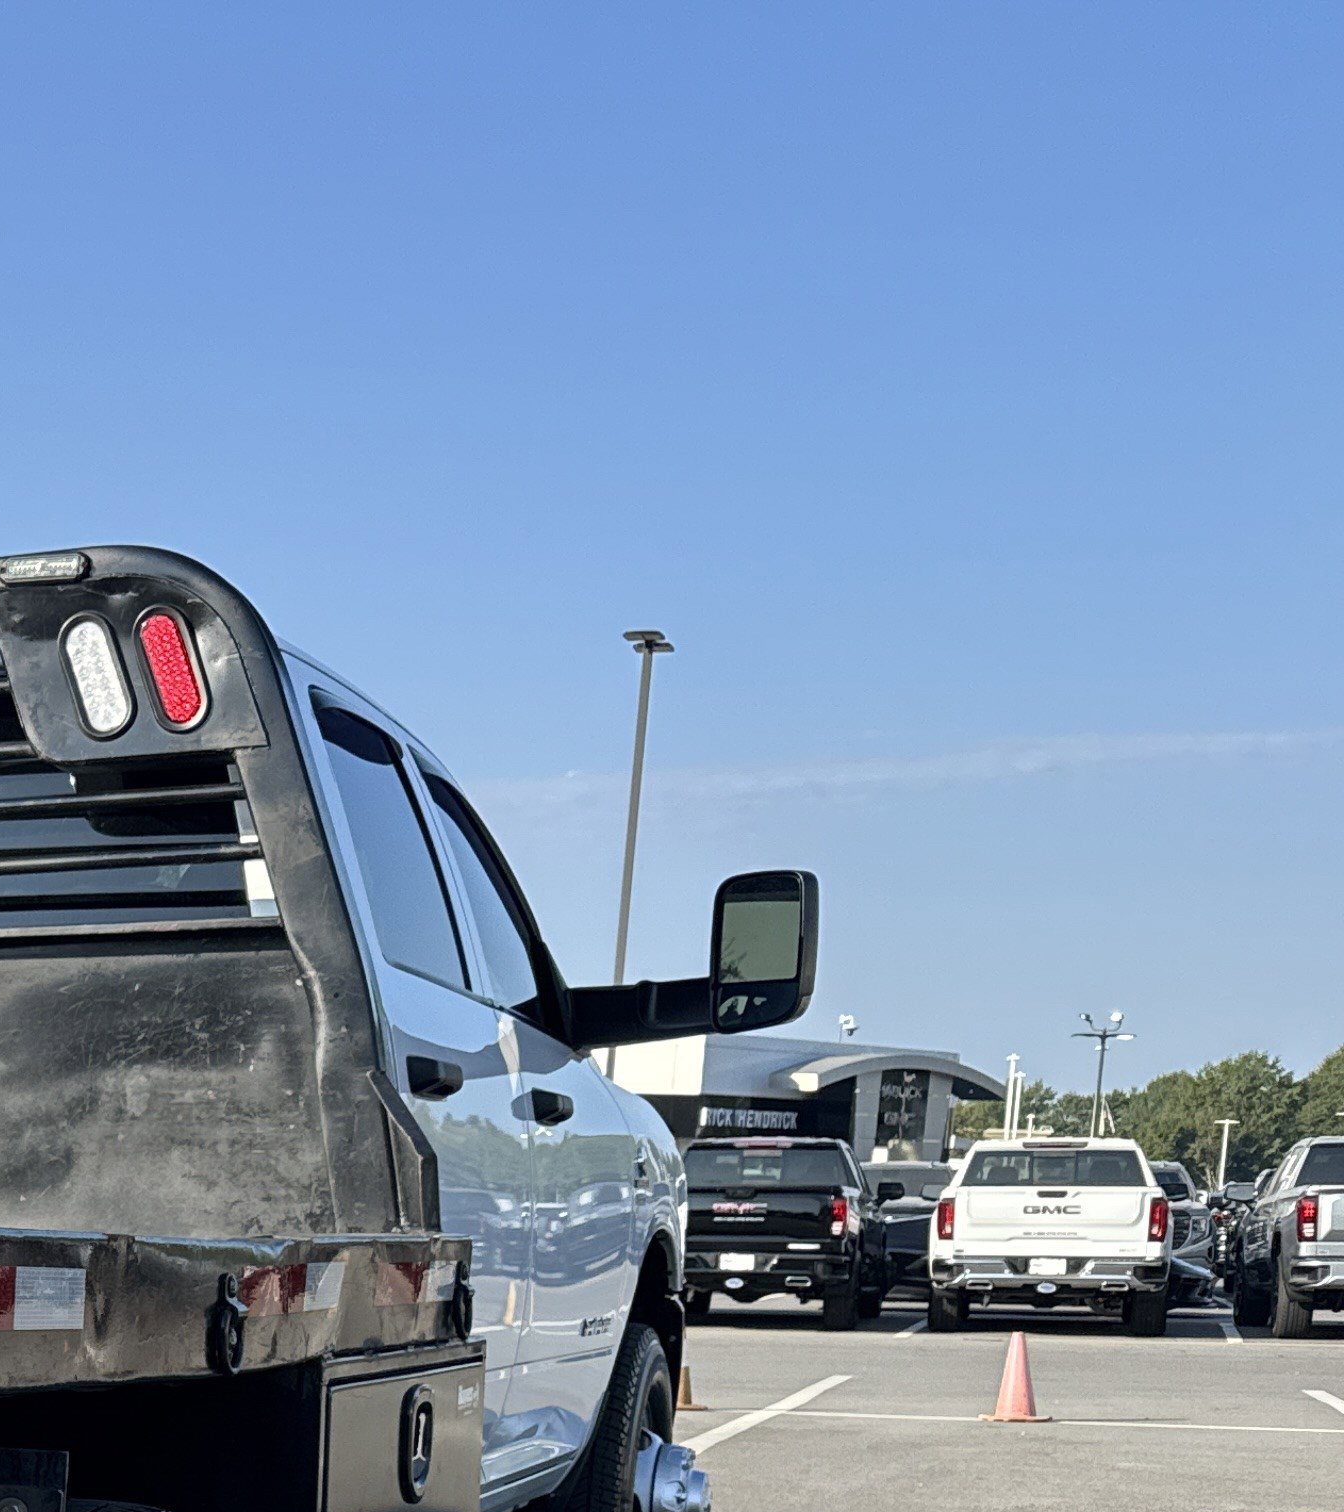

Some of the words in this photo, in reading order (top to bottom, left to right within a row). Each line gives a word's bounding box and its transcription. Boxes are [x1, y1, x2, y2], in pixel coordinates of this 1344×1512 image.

[700, 1107, 733, 1127] RICK
[735, 1109, 799, 1130] HENDRICK
[1023, 1205, 1081, 1214] GMC
